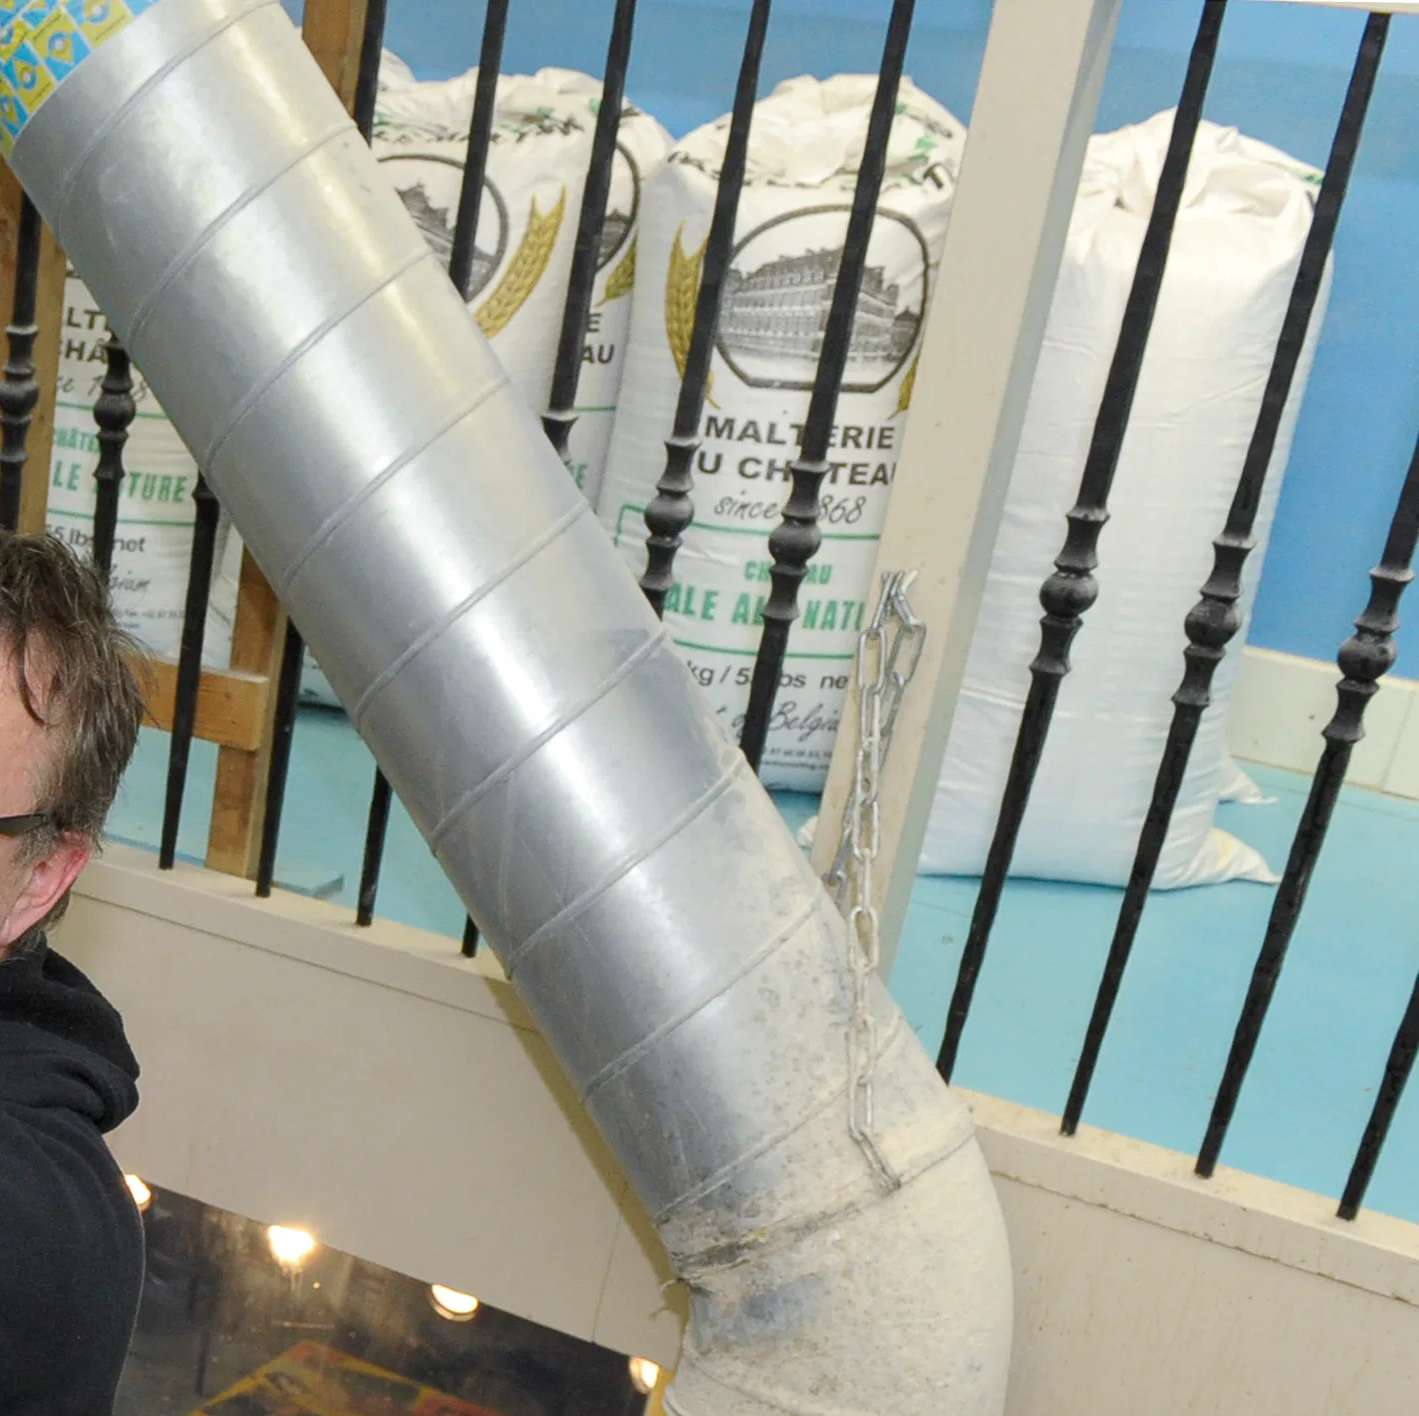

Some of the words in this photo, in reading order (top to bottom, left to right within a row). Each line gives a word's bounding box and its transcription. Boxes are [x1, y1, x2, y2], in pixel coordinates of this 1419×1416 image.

[52, 460, 82, 492] LE
[92, 470, 189, 504] TURE
[697, 451, 723, 475] U
[738, 456, 896, 486] CHTEA
[818, 494, 867, 525] 868
[664, 581, 719, 621] ALE
[819, 674, 850, 690] ne
